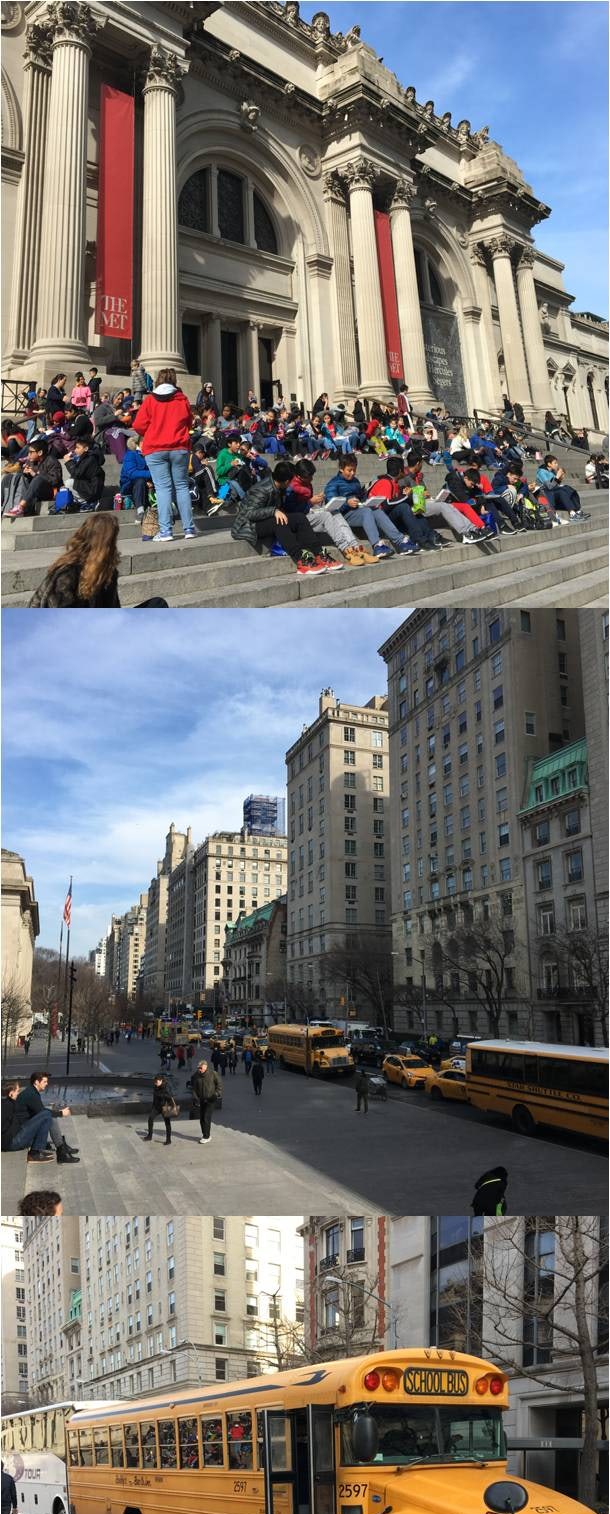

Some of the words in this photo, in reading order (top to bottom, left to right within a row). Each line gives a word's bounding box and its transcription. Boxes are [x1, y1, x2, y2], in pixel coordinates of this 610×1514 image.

[101, 295, 128, 313] THE
[406, 1370, 445, 1393] SCHOOL
[448, 1371, 466, 1393] BUS
[24, 1468, 41, 1479] TOUR
[233, 1481, 247, 1492] 2597
[339, 1484, 368, 1498] 2597
